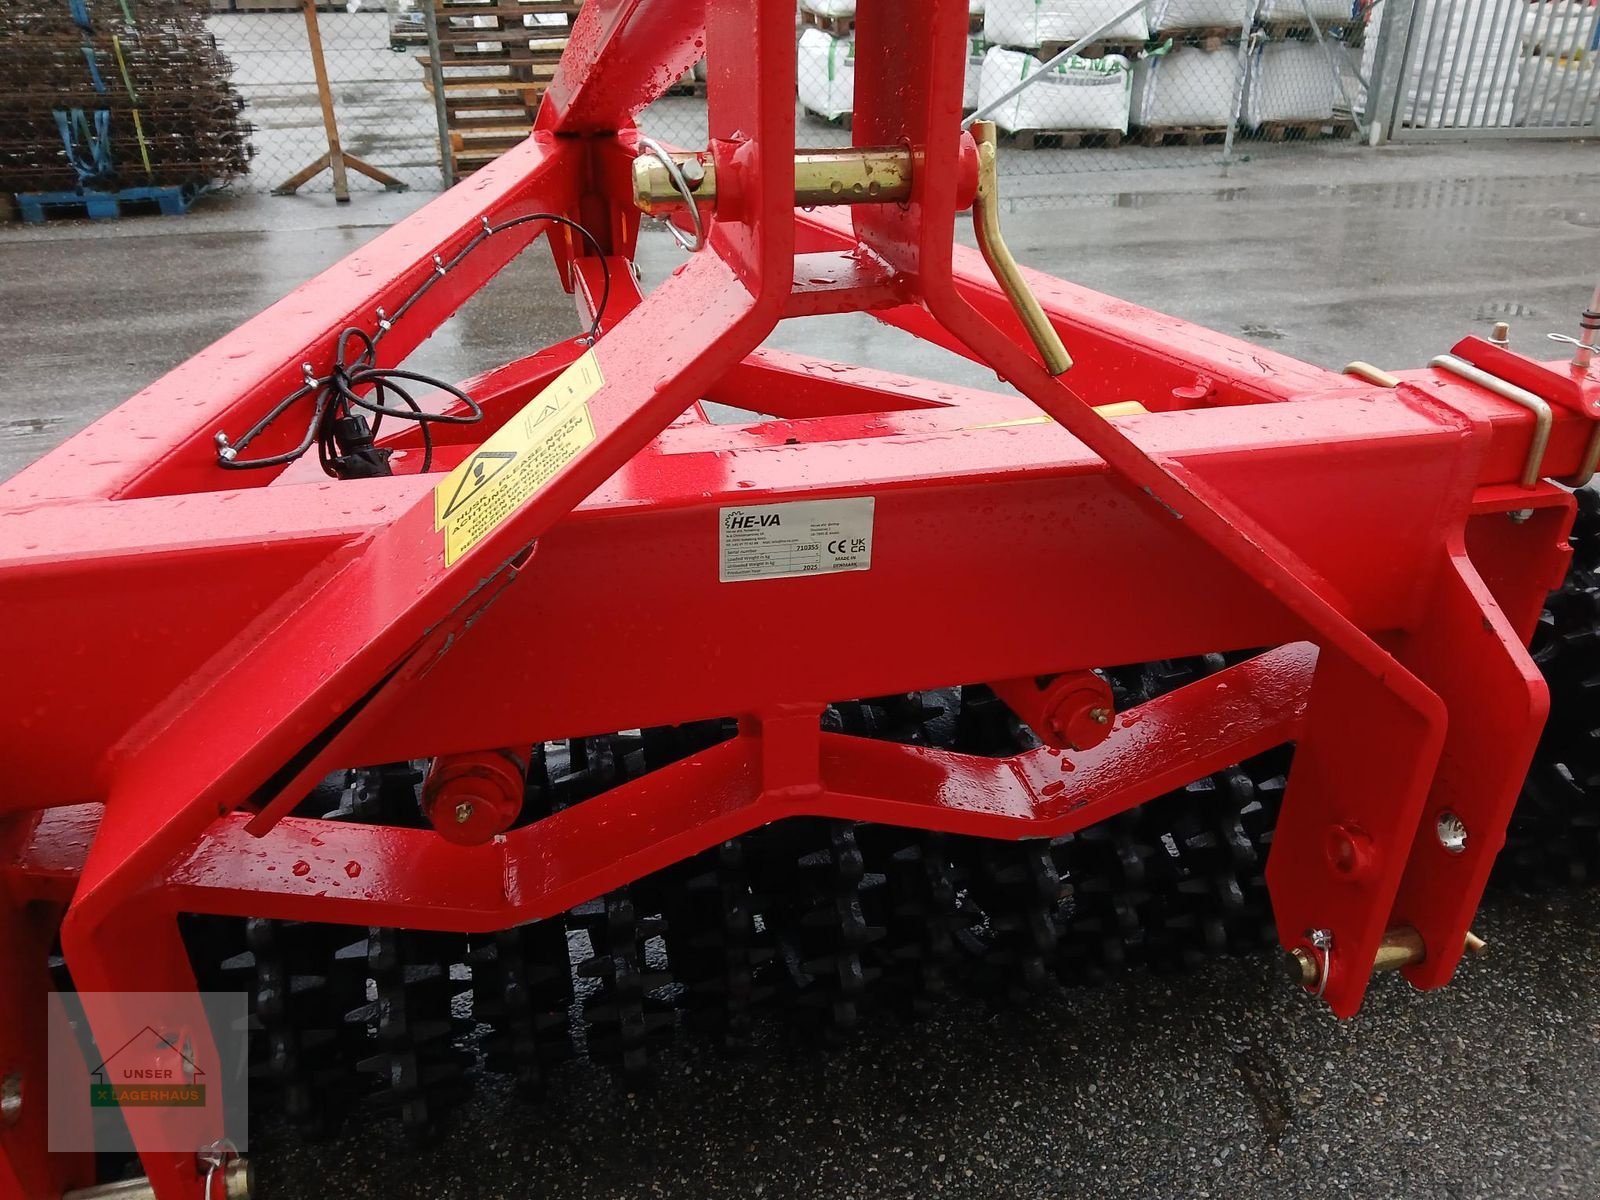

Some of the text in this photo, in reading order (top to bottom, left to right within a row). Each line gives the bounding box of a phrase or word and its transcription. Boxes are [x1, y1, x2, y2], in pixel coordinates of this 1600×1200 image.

[452, 483, 508, 536] ACHTUNG
[519, 417, 583, 476] ATTENTION
[456, 493, 487, 524] HUSK
[498, 445, 542, 487] PLEASE
[545, 415, 577, 445] NOTE
[731, 514, 781, 530] HE-VA
[851, 538, 865, 546] UK
[851, 545, 866, 553] CA
